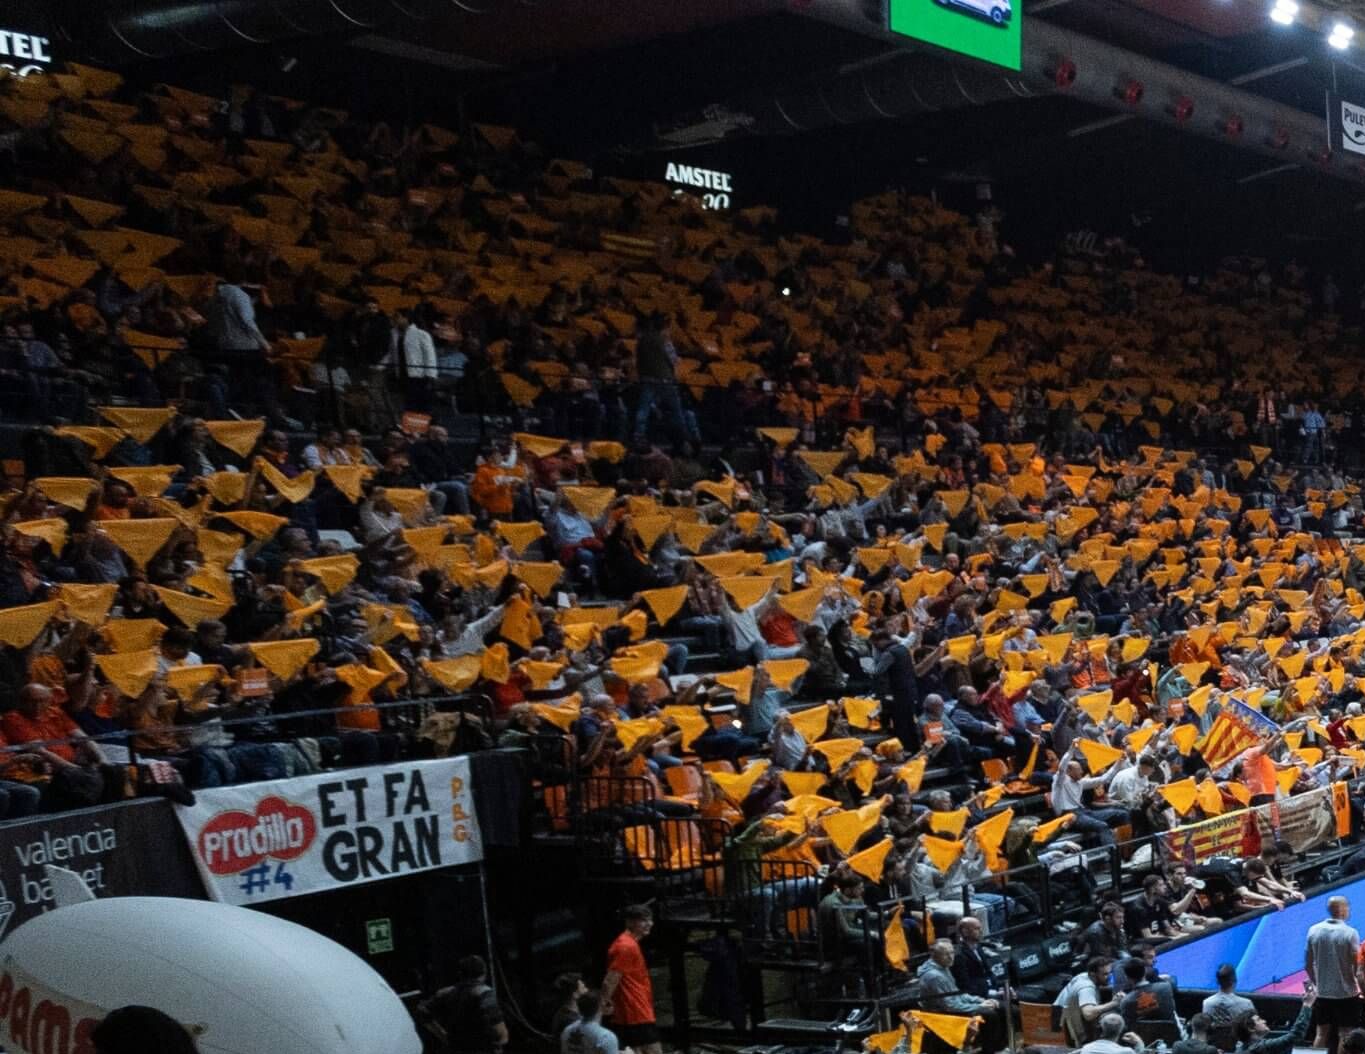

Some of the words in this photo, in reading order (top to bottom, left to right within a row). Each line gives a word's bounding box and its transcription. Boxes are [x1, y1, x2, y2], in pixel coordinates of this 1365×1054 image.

[665, 162, 733, 193] AMSTEL
[317, 778, 368, 828] ET
[383, 769, 431, 818] FA
[14, 822, 117, 867] valencia
[321, 814, 443, 883] GRAN
[20, 862, 107, 905] baet
[239, 862, 294, 895] #4
